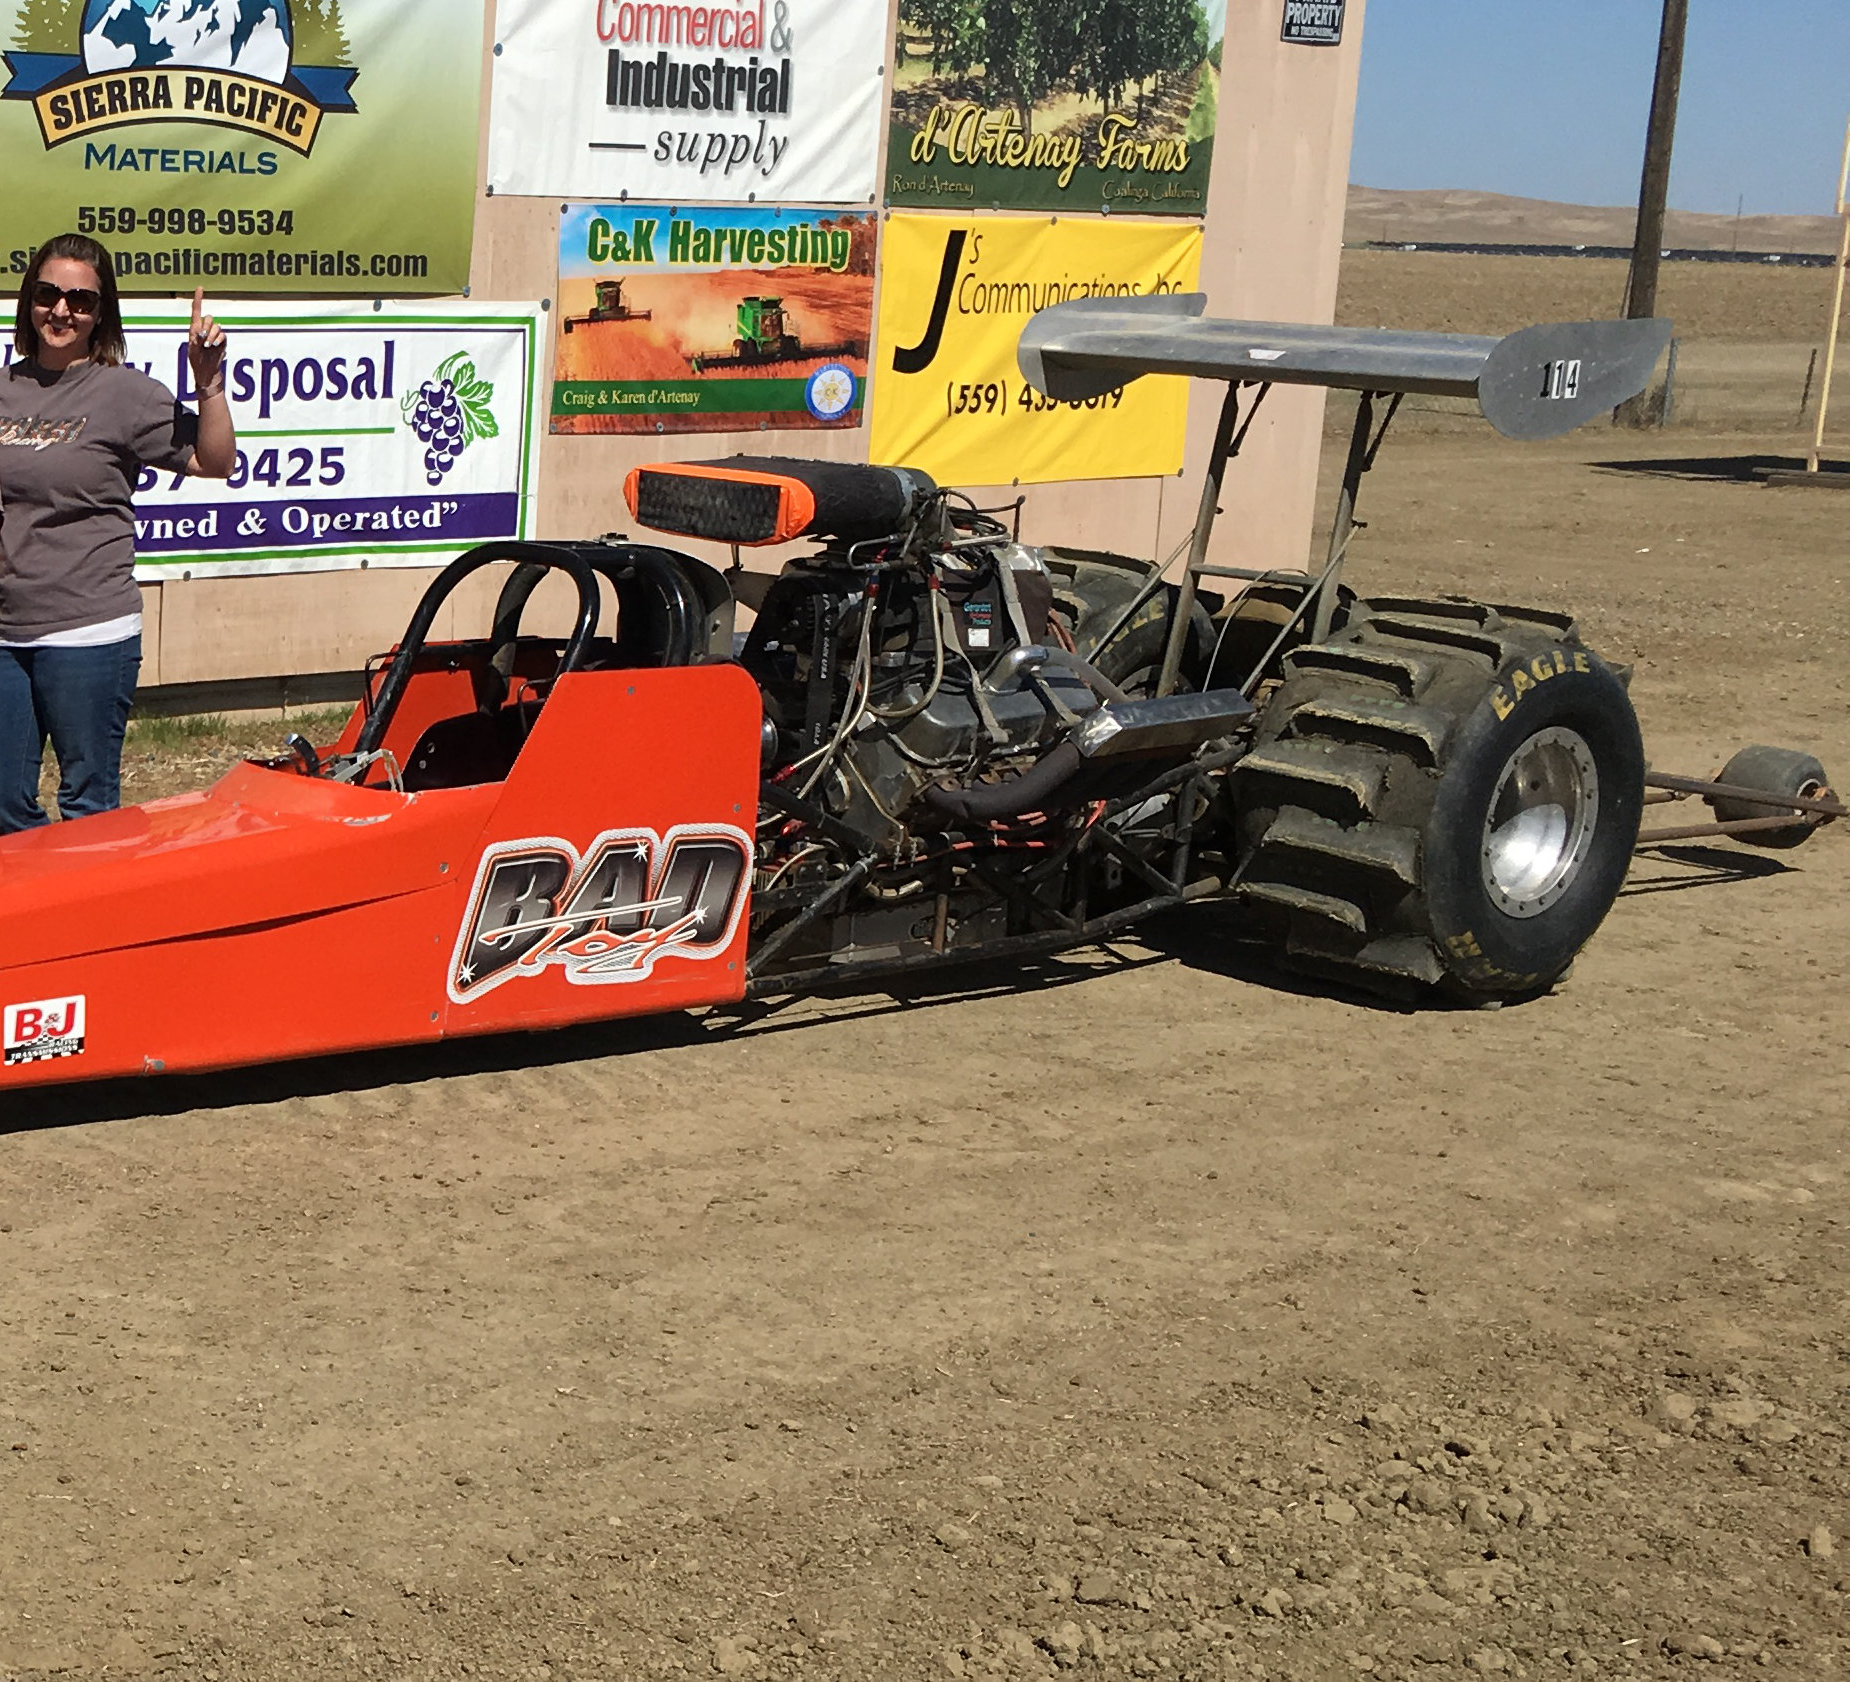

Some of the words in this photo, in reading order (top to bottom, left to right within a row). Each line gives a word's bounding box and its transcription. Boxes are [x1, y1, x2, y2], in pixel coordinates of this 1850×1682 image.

[596, 0, 764, 50] Commercial
[770, 0, 792, 53] &
[1285, 2, 1341, 26] PROPERTY
[49, 75, 172, 131] SIERRA
[184, 76, 308, 137] PACIFIC
[606, 48, 790, 114] Industrial
[84, 142, 279, 175] MATERIALS
[653, 120, 789, 176] supply
[1097, 112, 1191, 172] Farms
[78, 206, 294, 236] 559-998-9534
[588, 217, 659, 266] C&K
[669, 219, 852, 273] Harvesting
[562, 390, 595, 408] Craig
[598, 390, 608, 405] &
[611, 390, 648, 405] Karen
[947, 380, 1007, 417] (559)
[1539, 360, 1581, 399] 114
[236, 508, 267, 536] &
[1490, 650, 1591, 721] EAGLE
[452, 828, 752, 998] BAD
